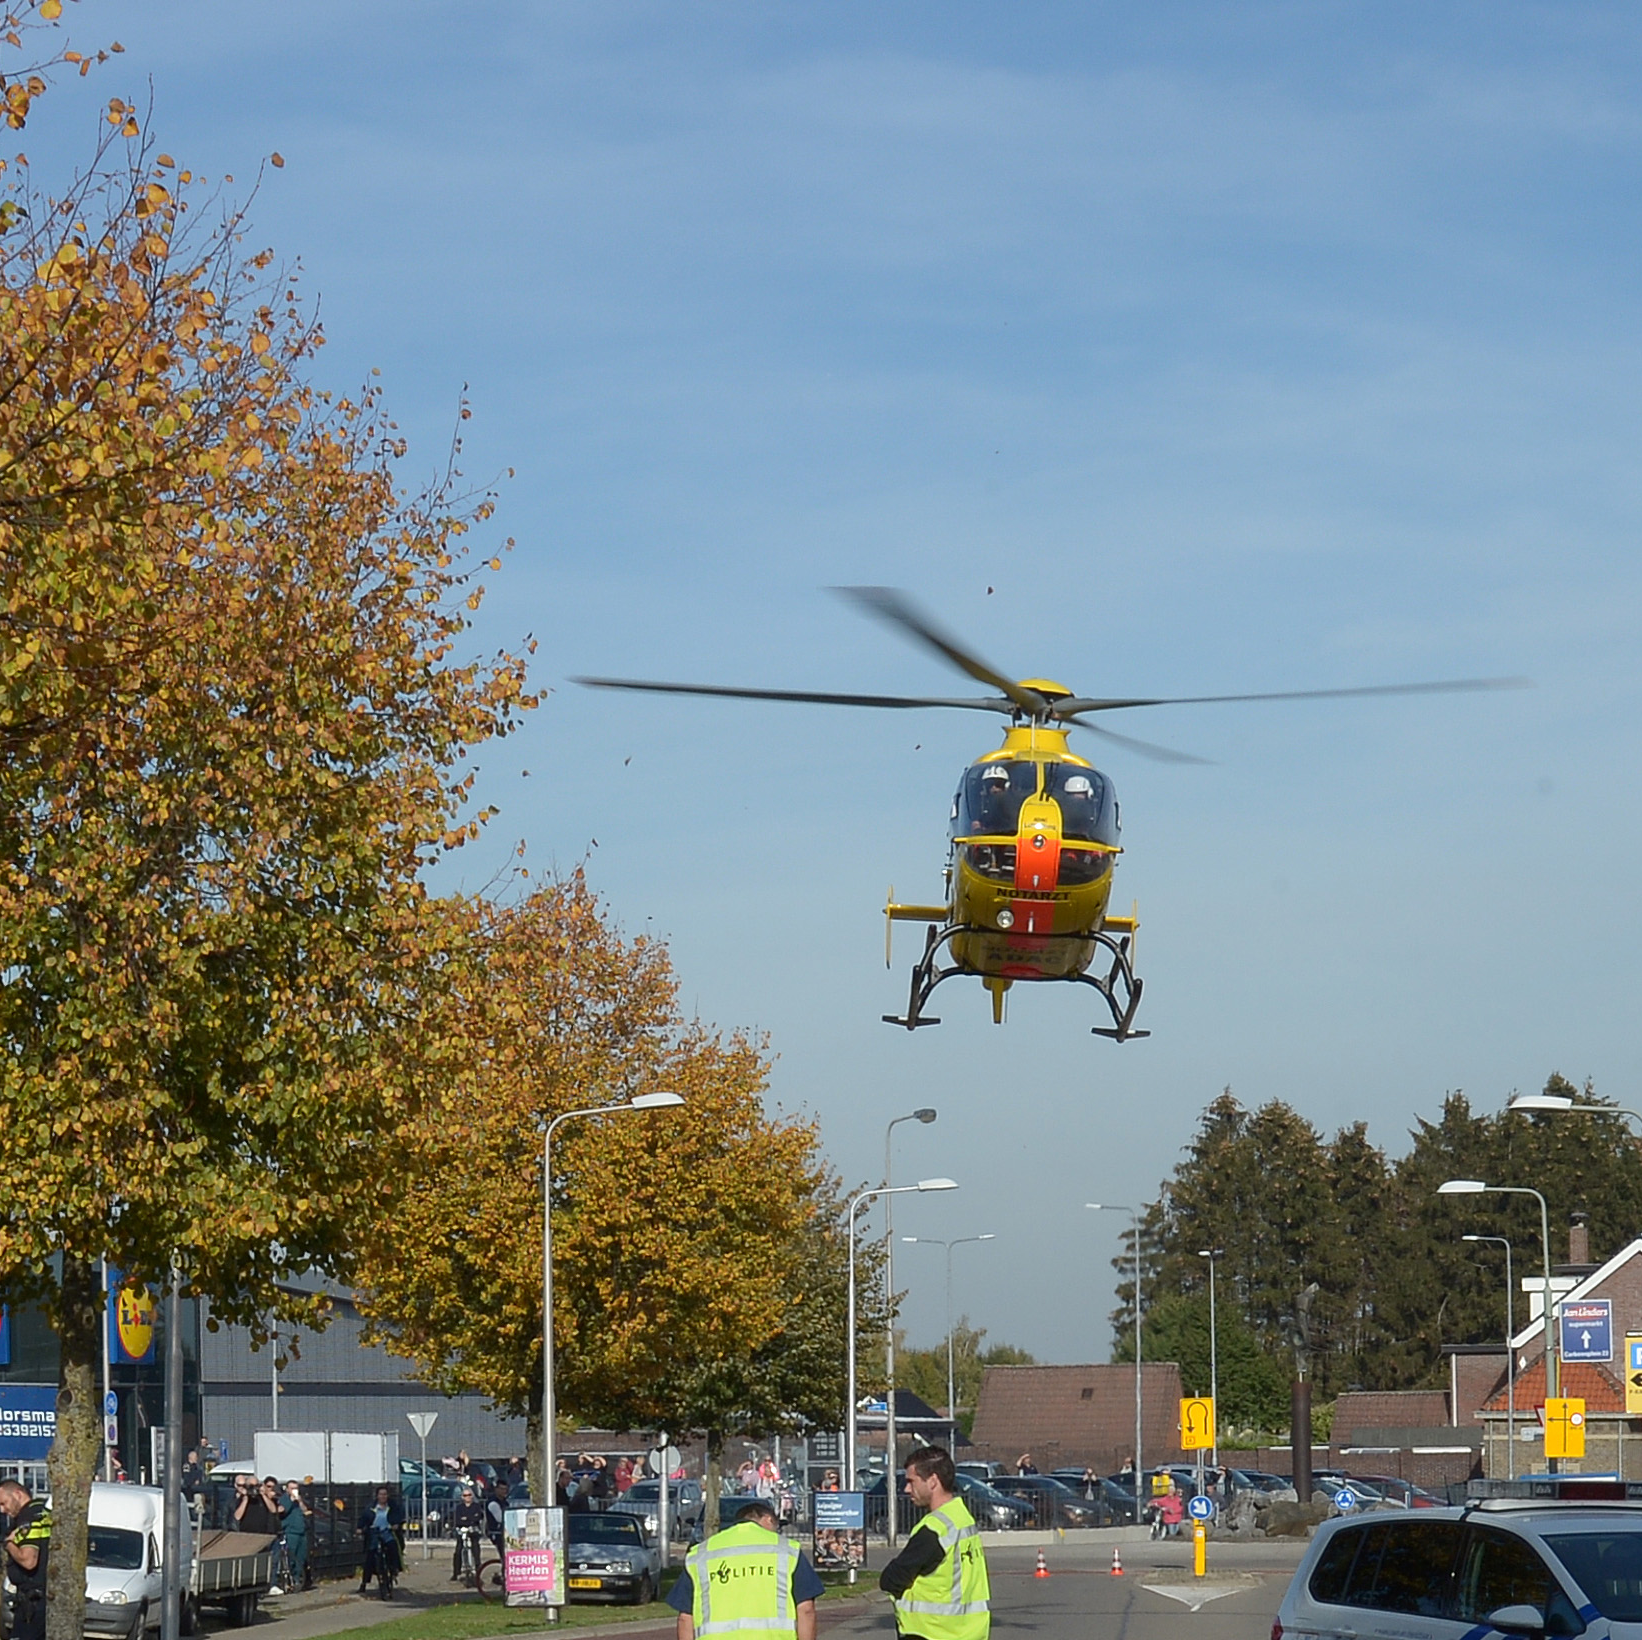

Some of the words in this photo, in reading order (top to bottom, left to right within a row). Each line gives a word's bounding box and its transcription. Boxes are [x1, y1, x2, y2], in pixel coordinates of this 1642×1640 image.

[997, 888, 1071, 901] NOTARZT
[508, 1554, 549, 1565] KERMIS
[508, 1565, 549, 1576] Heerlen
